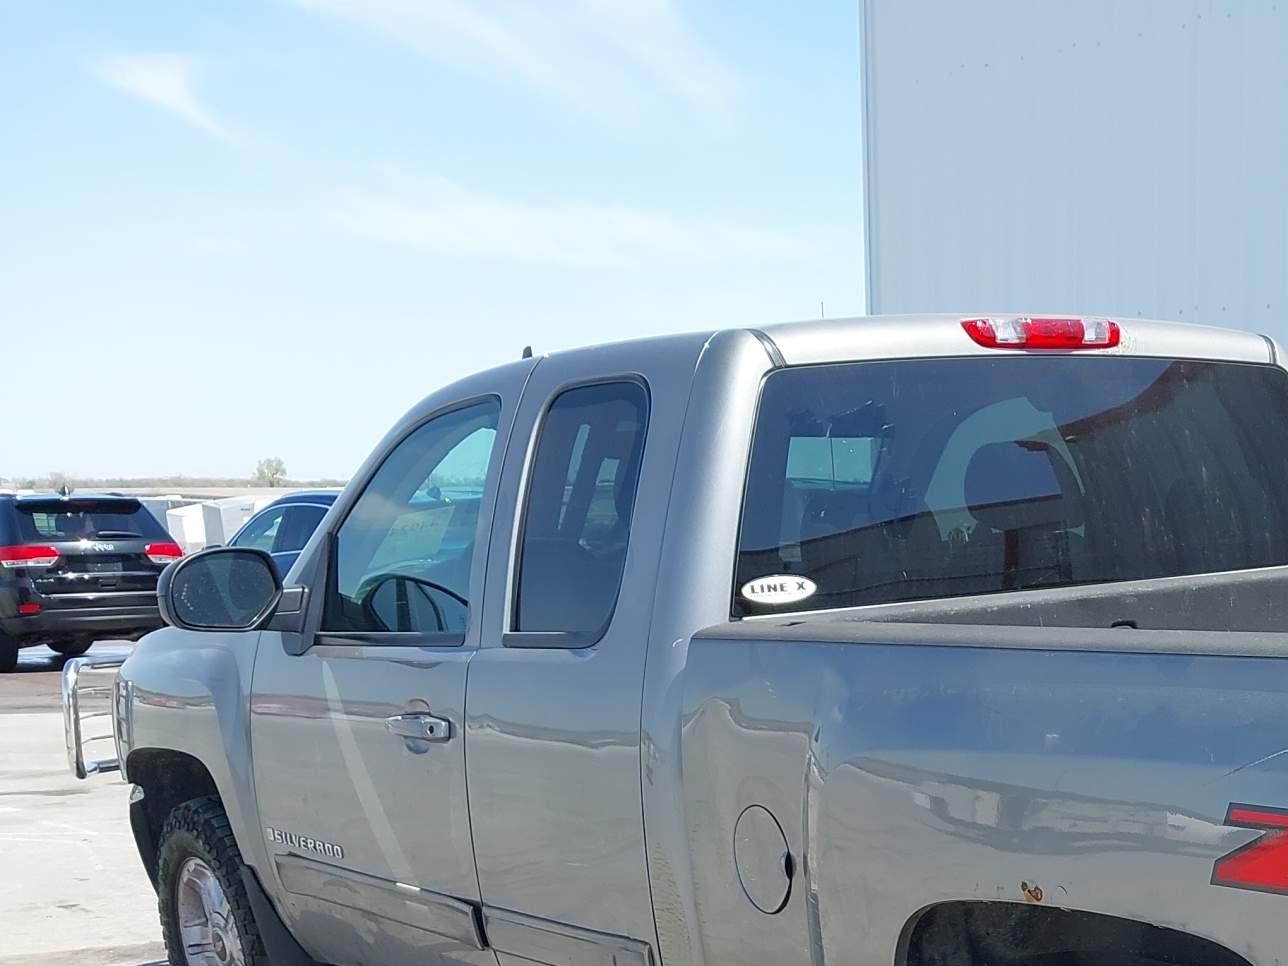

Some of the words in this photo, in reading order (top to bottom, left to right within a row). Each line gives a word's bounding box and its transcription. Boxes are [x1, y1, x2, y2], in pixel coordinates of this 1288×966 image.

[750, 583, 788, 594] LINE
[796, 582, 806, 591] X
[274, 829, 344, 859] SILVERADO
